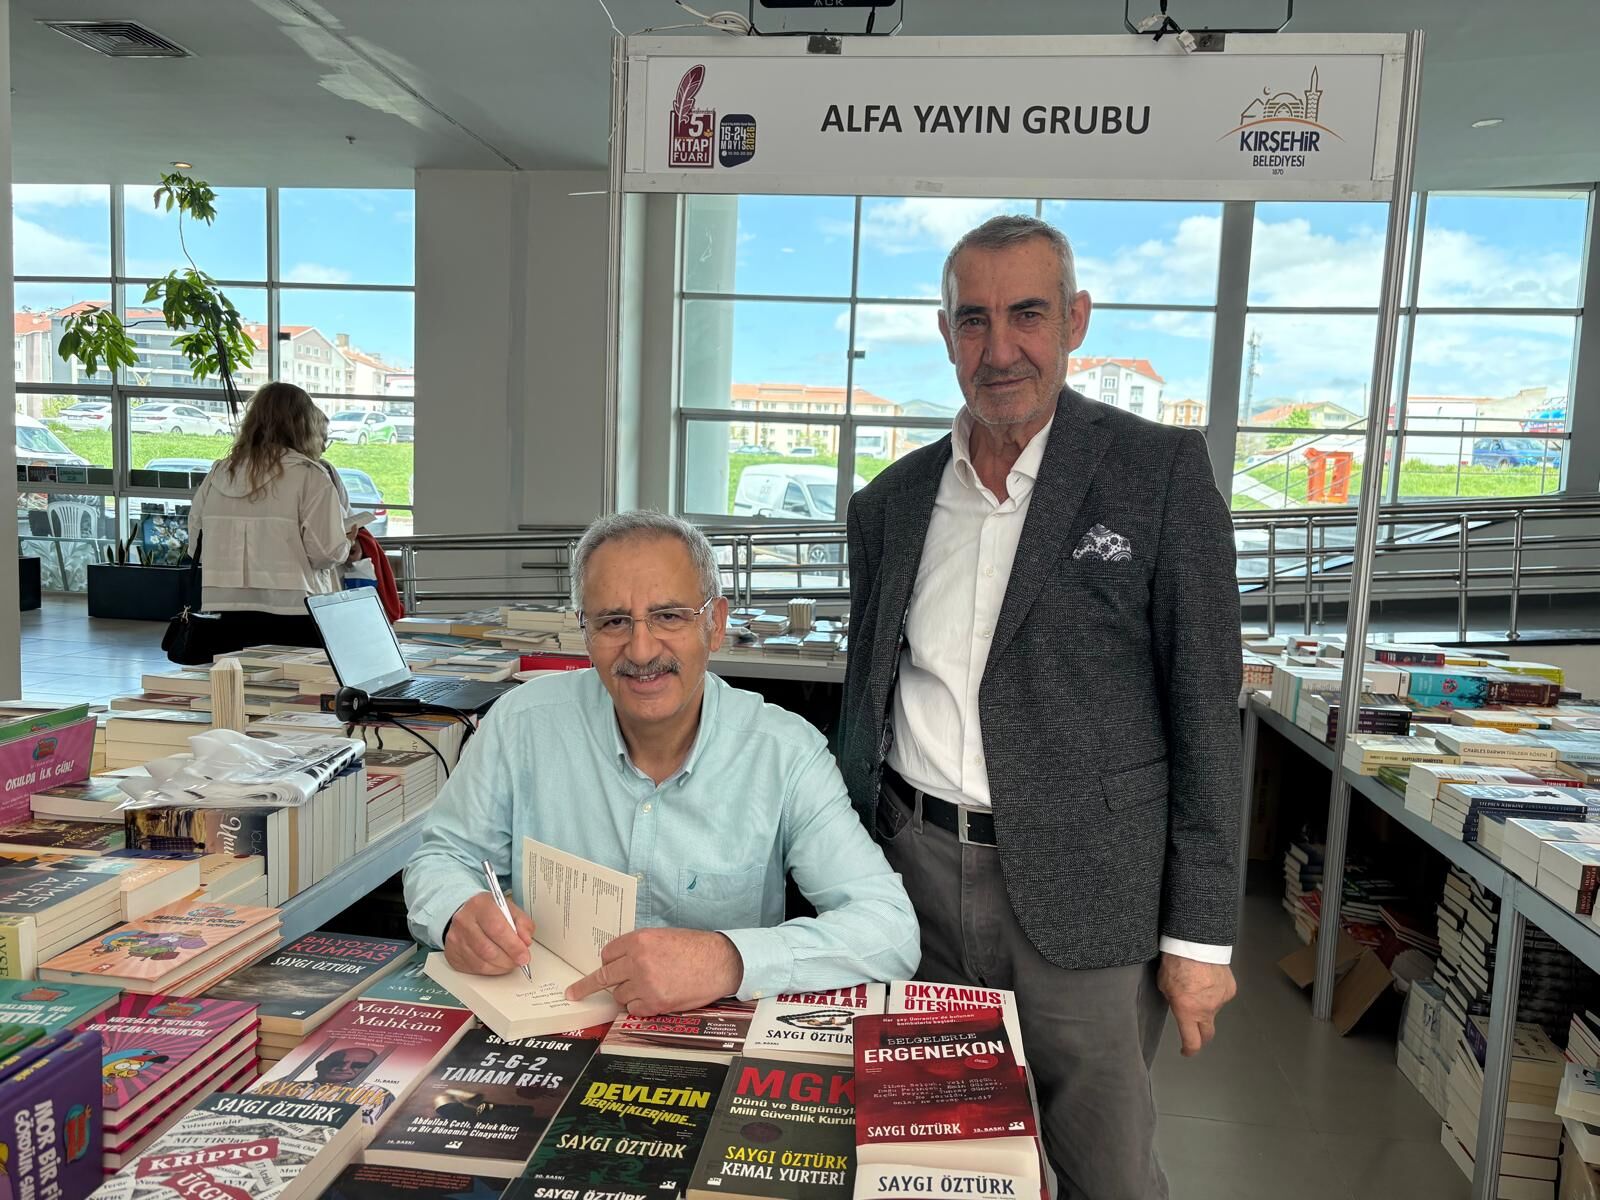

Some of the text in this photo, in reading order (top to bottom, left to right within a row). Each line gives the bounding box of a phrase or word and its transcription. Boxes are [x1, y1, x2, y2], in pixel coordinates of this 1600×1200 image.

[821, 104, 1152, 135] ALFA YAYIN GRUBU
[721, 127, 747, 141] 15-24
[1240, 130, 1320, 153] KIRŞEHİR
[674, 139, 708, 152] KİTAP
[721, 140, 747, 150] MAYIS
[674, 152, 707, 162] FUARI
[1253, 155, 1305, 167] BELEDİYESİ
[0, 876, 59, 904] ALTAN
[18, 876, 88, 908] AHMET
[288, 943, 391, 962] KUMPAS
[303, 936, 399, 952] BALYOZ'DA
[271, 956, 314, 969] SAYGI
[312, 961, 366, 974] ÖZTÜRK
[904, 984, 1001, 1005] OKYANUS
[352, 1003, 445, 1020] Madalyalı
[86, 1023, 147, 1033] HEYECAN
[352, 1015, 442, 1033] Mahkûm
[621, 1022, 699, 1034] KLASÖR
[486, 1034, 572, 1052] SAGI ÖZTÜRK
[766, 1029, 805, 1040] SAYGI
[887, 1032, 977, 1046] BELGELERLE
[480, 1051, 548, 1072] 5-6-2
[864, 1040, 1005, 1064] ERGENEKON
[440, 1067, 564, 1089] TAMAM REİS
[736, 1066, 855, 1105] MGK
[252, 1080, 391, 1105] SAYGI ÖZTÜRK
[585, 1082, 711, 1109] DEVLETİN
[212, 1097, 342, 1123] SAYGI ÖZTÜRK
[730, 1106, 757, 1117] Milli
[760, 1109, 815, 1123] Güvenlik
[733, 1097, 856, 1115] Dünü ve Bugünüyl
[34, 1099, 56, 1150] MOR
[411, 1117, 520, 1132] Abdullah Çatlı, Haluk Kırcı
[431, 1126, 468, 1136] Dönemin
[469, 1129, 517, 1140] Cinayetleri
[867, 1122, 962, 1138] SAYGI ÖZTÜRK
[14, 1109, 36, 1177] GÖRDÜM
[556, 1134, 688, 1159] SAYGI ÖZTÜRK
[38, 1147, 61, 1185] BİR
[148, 1145, 269, 1172] KRİPTO
[725, 1145, 848, 1170] SAYGI ÖZTÜRK
[720, 1161, 847, 1186] KEMAL YURTERİ
[534, 1187, 647, 1200] SAYGI ÖZTÜRK
[878, 1175, 1015, 1195] SAYGI ÖZTÜRK
